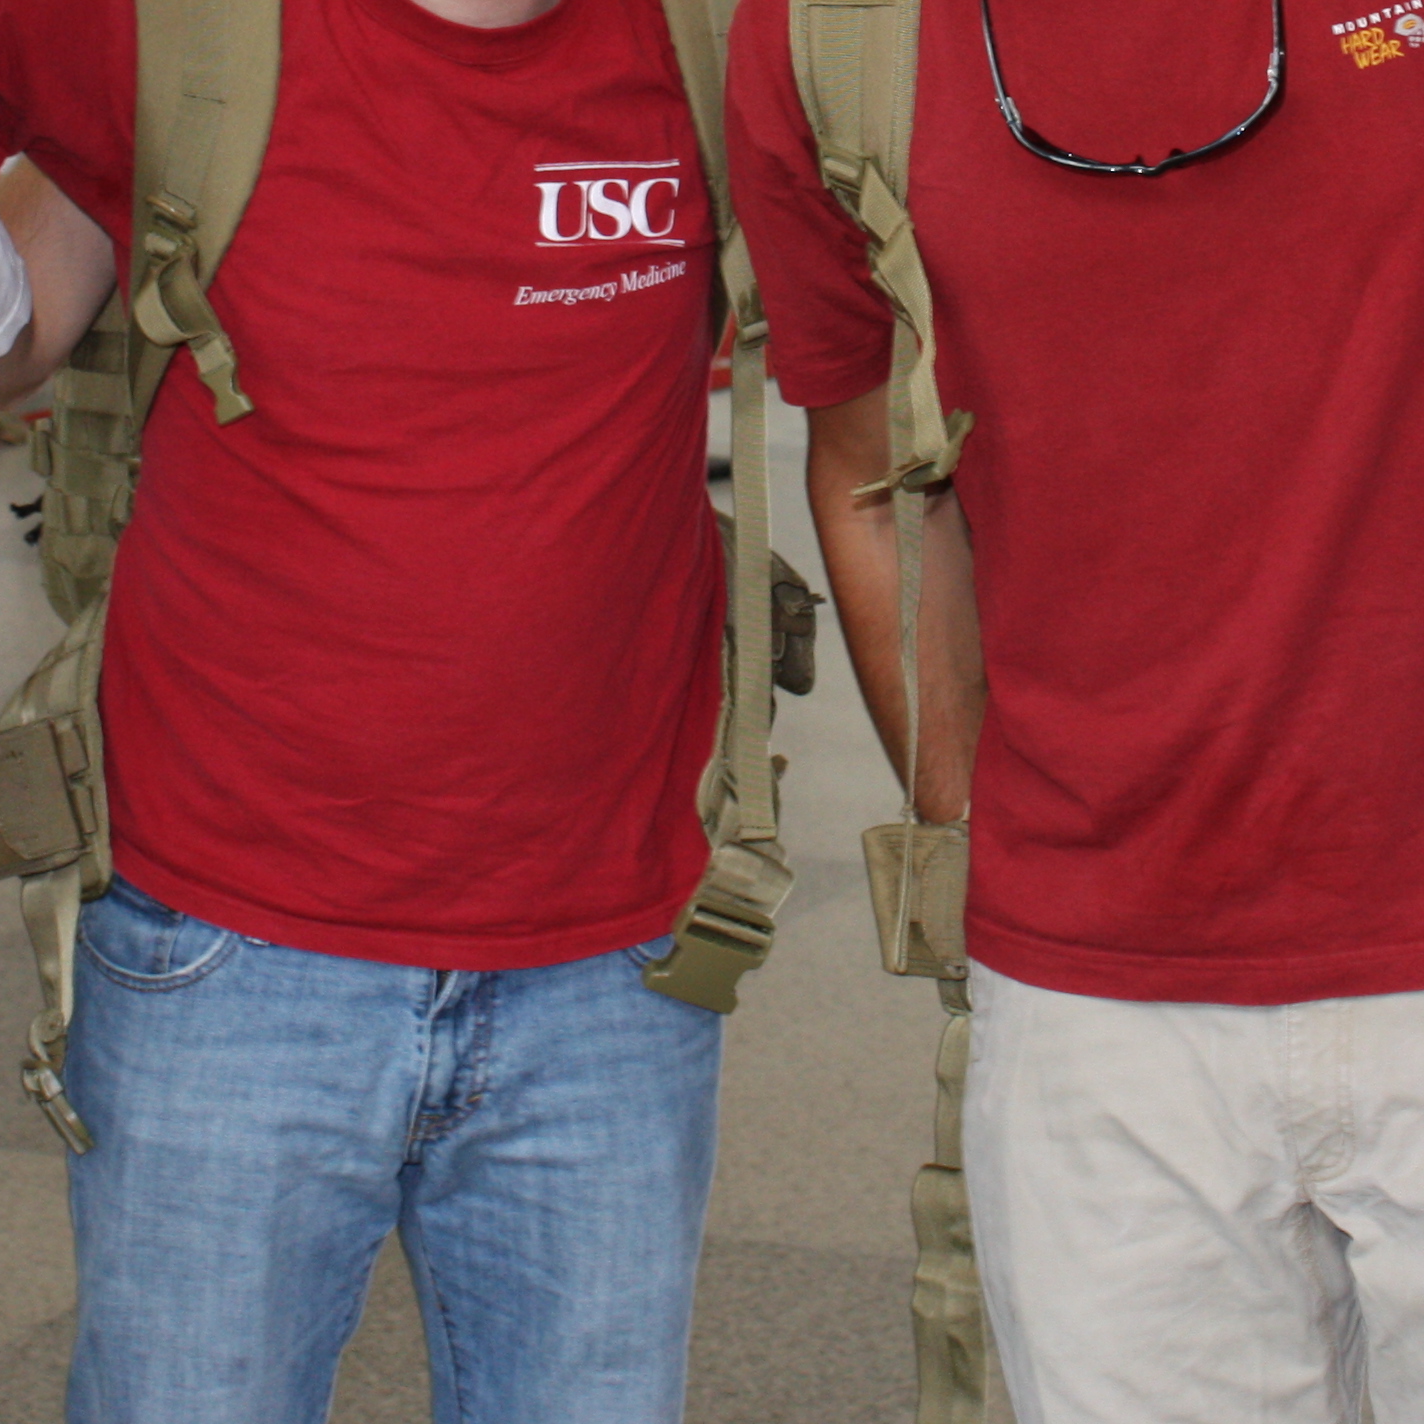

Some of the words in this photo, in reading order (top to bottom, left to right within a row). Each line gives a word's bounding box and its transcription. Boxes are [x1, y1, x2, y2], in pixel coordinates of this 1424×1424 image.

[1340, 27, 1385, 55] HARD
[1353, 39, 1405, 69] WEAR
[533, 178, 680, 242] USC
[513, 281, 618, 306] Emergency
[620, 261, 686, 293] Medicine
